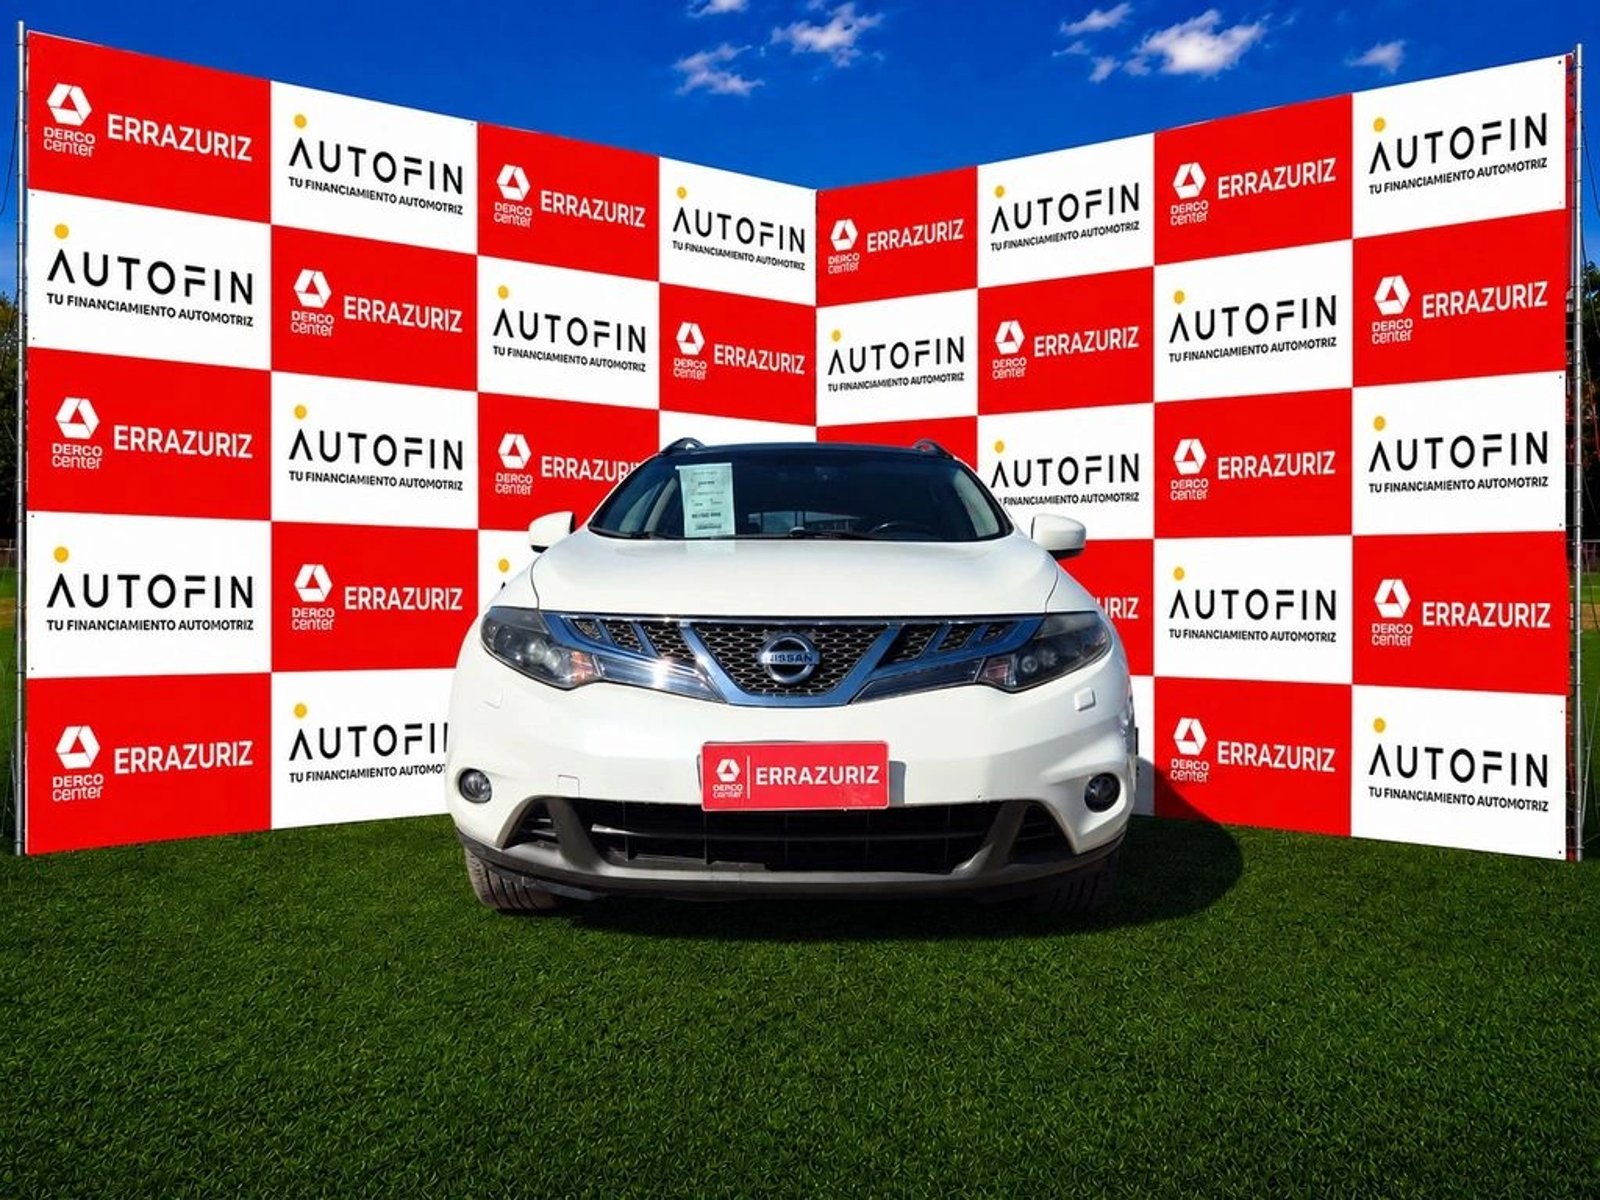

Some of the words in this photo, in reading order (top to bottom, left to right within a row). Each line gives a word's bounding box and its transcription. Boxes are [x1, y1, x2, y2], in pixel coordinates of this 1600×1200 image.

[44, 126, 95, 144] DERCO
[108, 113, 252, 161] ERRAZURIZ
[1368, 112, 1546, 174] AUTOFIN
[43, 138, 94, 156] center
[288, 137, 462, 195] AUTOFIN
[1368, 183, 1382, 194] TU
[1384, 168, 1475, 192] FINANCIAMIENTO
[1476, 157, 1547, 177] AUTOMOTRIZ
[1217, 157, 1336, 199] ERRAZURIZ
[288, 176, 303, 188] TU
[305, 179, 397, 204] FINANCIAMIENTO
[398, 195, 463, 215] AUTOMOTRIZ
[494, 202, 532, 217] DERCO
[540, 190, 645, 227] ERRAZURIZ
[990, 182, 1139, 234] AUTOFIN
[1170, 200, 1208, 215] DERCO
[1171, 210, 1208, 225] center
[494, 212, 531, 226] center
[672, 206, 805, 254] AUTOFIN
[867, 218, 963, 252] ERRAZURIZ
[990, 242, 1002, 251] TU
[1003, 230, 1079, 249] FINANCIAMIENTO
[1080, 220, 1139, 238] AUTOMOTRIZ
[672, 240, 683, 250] TU
[685, 242, 755, 262] FINANCIAMIENTO
[755, 255, 805, 271] AUTOMOTRIZ
[828, 252, 860, 265] DERCO
[47, 248, 252, 305] AUTOFIN
[829, 261, 859, 274] center
[46, 292, 63, 305] TU
[67, 294, 176, 318] FINANCIAMIENTO
[178, 308, 253, 327] AUTOMOTRIZ
[1422, 281, 1547, 319] ERRAZURIZ
[291, 310, 334, 325] DERCO
[344, 295, 462, 333] ERRAZURIZ
[1169, 294, 1336, 343] AUTOFIN
[291, 321, 333, 336] center
[493, 308, 645, 353] AUTOFIN
[1372, 318, 1412, 332] DERCO
[1034, 326, 1139, 357] ERRAZURIZ
[1372, 329, 1412, 344] center
[493, 345, 505, 356] TU
[507, 347, 588, 366] FINANCIAMIENTO
[589, 357, 646, 372] AUTOMOTRIZ
[714, 343, 805, 375] ERRAZURIZ
[827, 336, 964, 375] AUTOFIN
[1169, 352, 1181, 362] TU
[1183, 343, 1269, 361] FINANCIAMIENTO
[1270, 336, 1337, 352] AUTOMOTRIZ
[673, 366, 706, 379] center
[674, 357, 707, 370] DERCO
[993, 357, 1027, 369] DERCO
[993, 367, 1025, 379] center
[827, 383, 838, 392] TU
[839, 377, 909, 390] FINANCIAMIENTO
[910, 372, 964, 385] AUTOMOTRIZ
[52, 443, 102, 457] DERCO
[114, 424, 252, 458] ERRAZURIZ
[288, 428, 462, 470] AUTOFIN
[1368, 430, 1547, 472] AUTOFIN
[52, 454, 101, 469] center
[541, 455, 642, 482] ERRAZUR
[991, 453, 1139, 488] AUTOFIN
[1218, 450, 1335, 479] ERRAZURIZ
[289, 470, 303, 481] TU
[305, 471, 397, 487] FINANCIAMIENTO
[398, 477, 463, 491] AUTOMOTRIZ
[495, 472, 533, 485] DERCO
[495, 483, 531, 495] center
[1171, 478, 1208, 489] DERCO
[1369, 483, 1382, 493] TU
[1384, 479, 1475, 492] FINANCIAMIENTO
[1477, 476, 1548, 489] AUTOMOTRIZ
[1003, 494, 1079, 506] FINANCIAMIENTO
[1080, 491, 1139, 503] AUTOMOTRIZ
[1170, 489, 1207, 500] center
[46, 573, 253, 609] AUTOFIN
[344, 586, 462, 610] ERRAZURIZ
[292, 607, 334, 618] DERCO
[1169, 588, 1336, 621] AUTOFIN
[46, 619, 64, 631] TU
[66, 619, 176, 631] FINANCIAMIENTO
[178, 619, 253, 630] AUTOMOTRIZ
[292, 618, 334, 630] center
[1422, 602, 1550, 629] ERRAZURIZ
[1169, 628, 1181, 639] TU
[1183, 628, 1269, 641] FINANCIAMIENTO
[1270, 630, 1336, 643] AUTOMOTRIZ
[1372, 623, 1412, 634] DERCO
[1372, 633, 1412, 646] center
[114, 740, 253, 774] ERRAZURIZ
[1171, 758, 1209, 771] DERCO
[1217, 740, 1335, 772] ERRAZURIZ
[1368, 743, 1547, 788] AUTOFIN
[52, 773, 104, 788] DERCO
[289, 772, 303, 783] TU
[305, 766, 397, 781] FINANCIAMIENTO
[755, 765, 880, 786] ERRAZURIZ
[1170, 769, 1208, 782] center
[52, 786, 102, 801] center
[1368, 786, 1382, 798] TU
[1384, 787, 1475, 806] FINANCIAMIENTO
[1476, 795, 1548, 812] AUTOMOTRIZ
